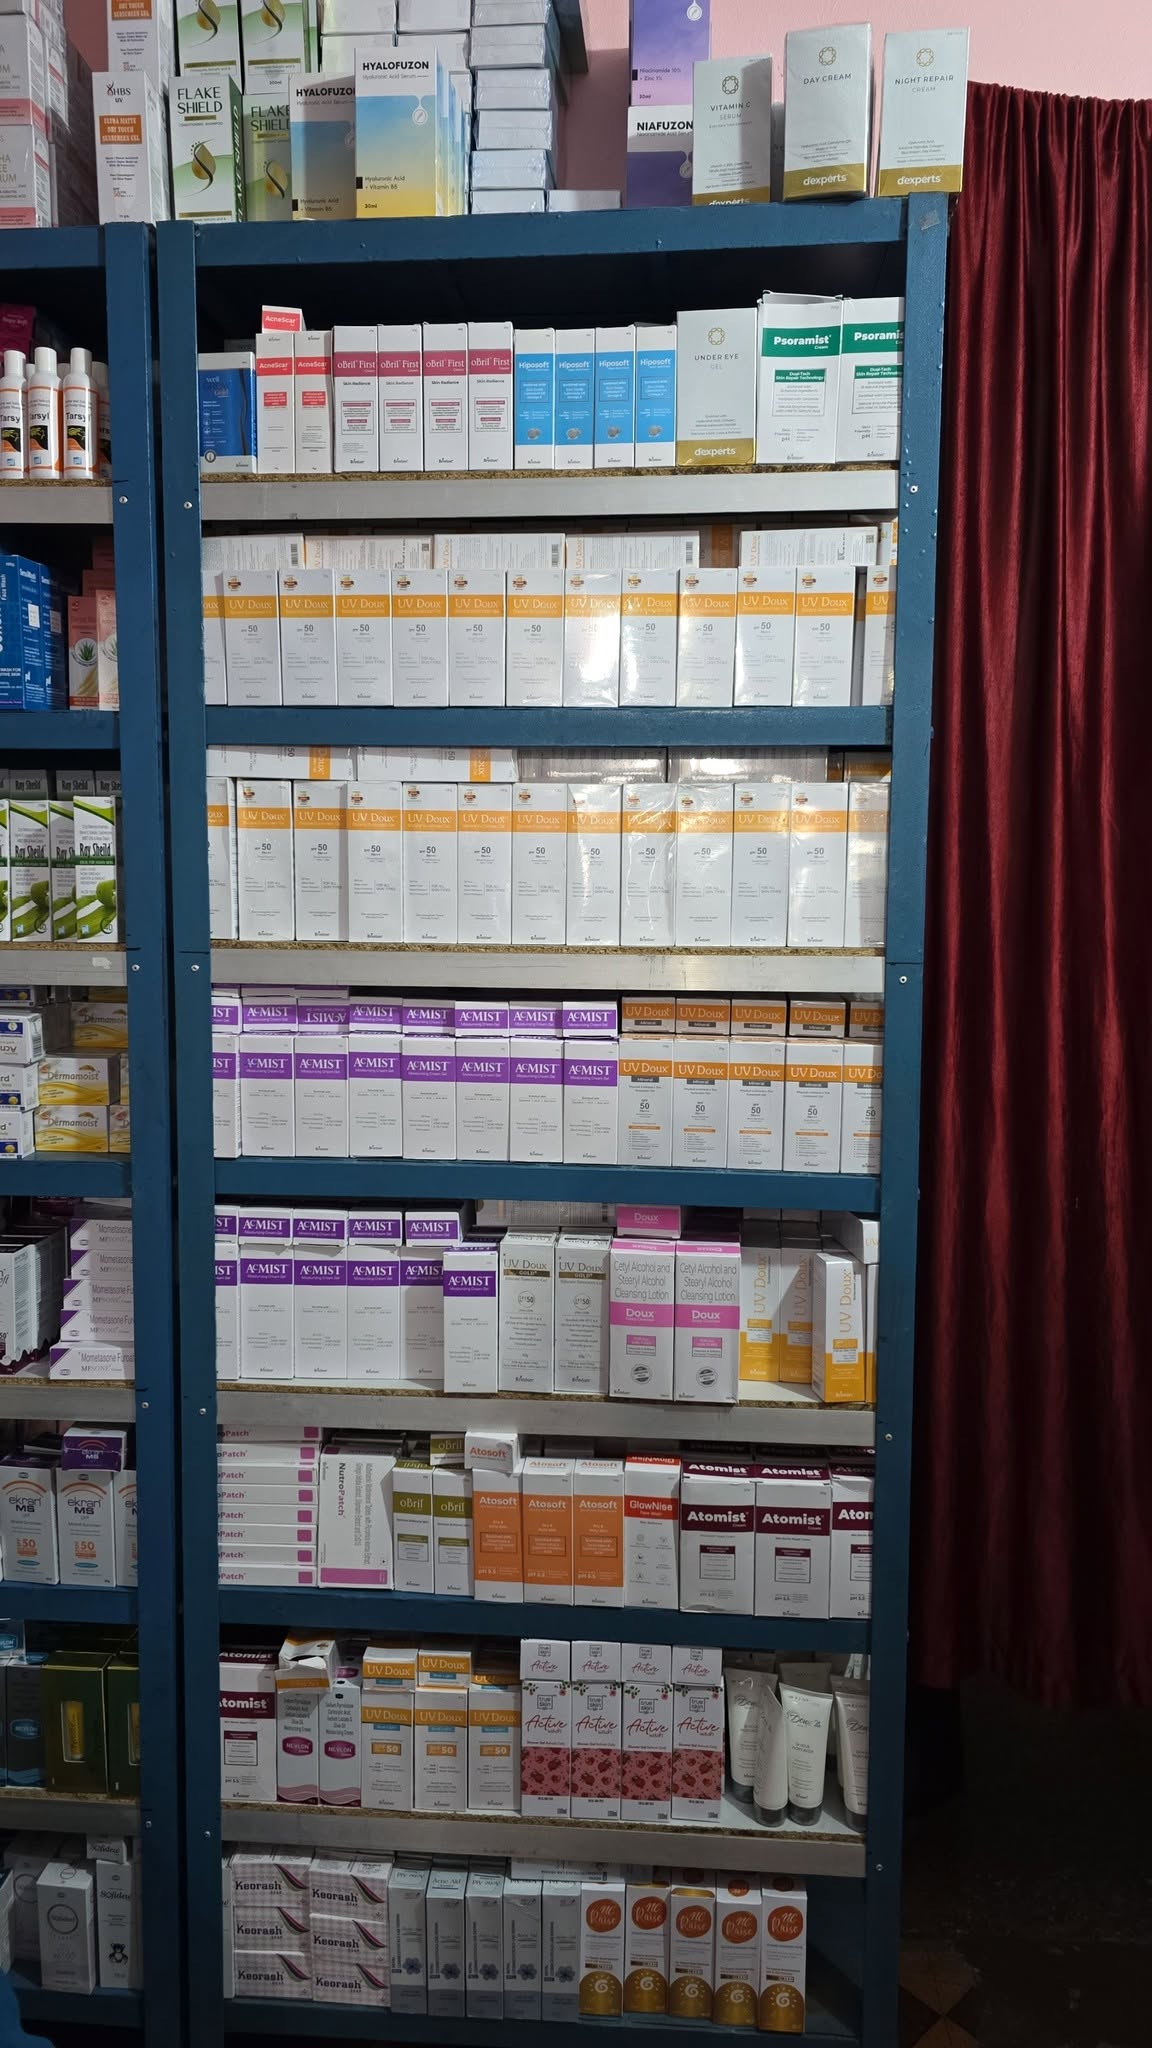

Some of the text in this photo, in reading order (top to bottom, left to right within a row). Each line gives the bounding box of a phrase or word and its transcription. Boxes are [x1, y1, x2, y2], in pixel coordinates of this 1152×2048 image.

[362, 61, 429, 70] HYALOFUZON
[803, 73, 852, 85] DAY CREAM
[895, 75, 954, 85] NIGHT REPAIR
[178, 87, 221, 99] FLAKE
[178, 101, 222, 113] SHIELD
[710, 103, 743, 112] VITAMIN
[637, 120, 693, 130] NIAFUZON
[265, 316, 296, 324] AcneScar
[774, 335, 829, 346] Psoramist
[298, 361, 326, 369] AcneScar
[337, 360, 375, 369] oBril First
[426, 359, 464, 368] oBril First
[471, 357, 510, 366] oBril First
[519, 361, 549, 370] Hiposoft
[599, 360, 629, 368] Hiposoft
[640, 359, 671, 367] Hiposoft
[229, 600, 272, 609] UV Doux
[341, 599, 384, 608] UV Doux
[455, 599, 497, 608] UV Doux
[743, 596, 788, 606] UV Doux
[802, 597, 848, 607] UV Doux
[243, 812, 284, 821] UV Doux
[352, 813, 394, 823] UV Doux
[463, 815, 505, 824] UV Doux
[795, 815, 840, 824] UV Doux
[80, 843, 111, 857] Ray Sheild
[757, 847, 767, 855] 50
[625, 1006, 670, 1017] UV Doux
[623, 1062, 668, 1073] UV Doux
[734, 1066, 780, 1077] UV Doux
[790, 1067, 837, 1078] UV Doux
[48, 1072, 99, 1080] Dermamoist
[640, 1102, 650, 1110] 50
[751, 1106, 761, 1114] 50
[48, 1118, 98, 1127] Dermamoist
[634, 1213, 658, 1222] Doux
[504, 1259, 547, 1269] UV Doux
[559, 1262, 602, 1272] UV Doux
[614, 1261, 670, 1273] Cetyl Alcohol and
[618, 1275, 665, 1287] Stearyl Alcohol
[615, 1288, 669, 1301] Cleansing Lotion
[626, 1309, 654, 1318] Doux
[692, 1310, 720, 1320] Doux
[470, 1447, 507, 1458] Atosoft
[689, 1464, 746, 1474] Atomist
[338, 1462, 346, 1516] NutroPatch
[9, 1496, 41, 1506] ekran
[68, 1498, 101, 1507] ekran
[479, 1496, 517, 1506] Atosoft
[579, 1500, 617, 1509] Atosoft
[74, 1507, 94, 1515] MS
[687, 1511, 746, 1523] Atomist
[762, 1513, 821, 1525] Atomist
[80, 1541, 94, 1550] 50
[422, 1658, 465, 1669] UV Doux
[367, 1665, 410, 1676] UV Doux
